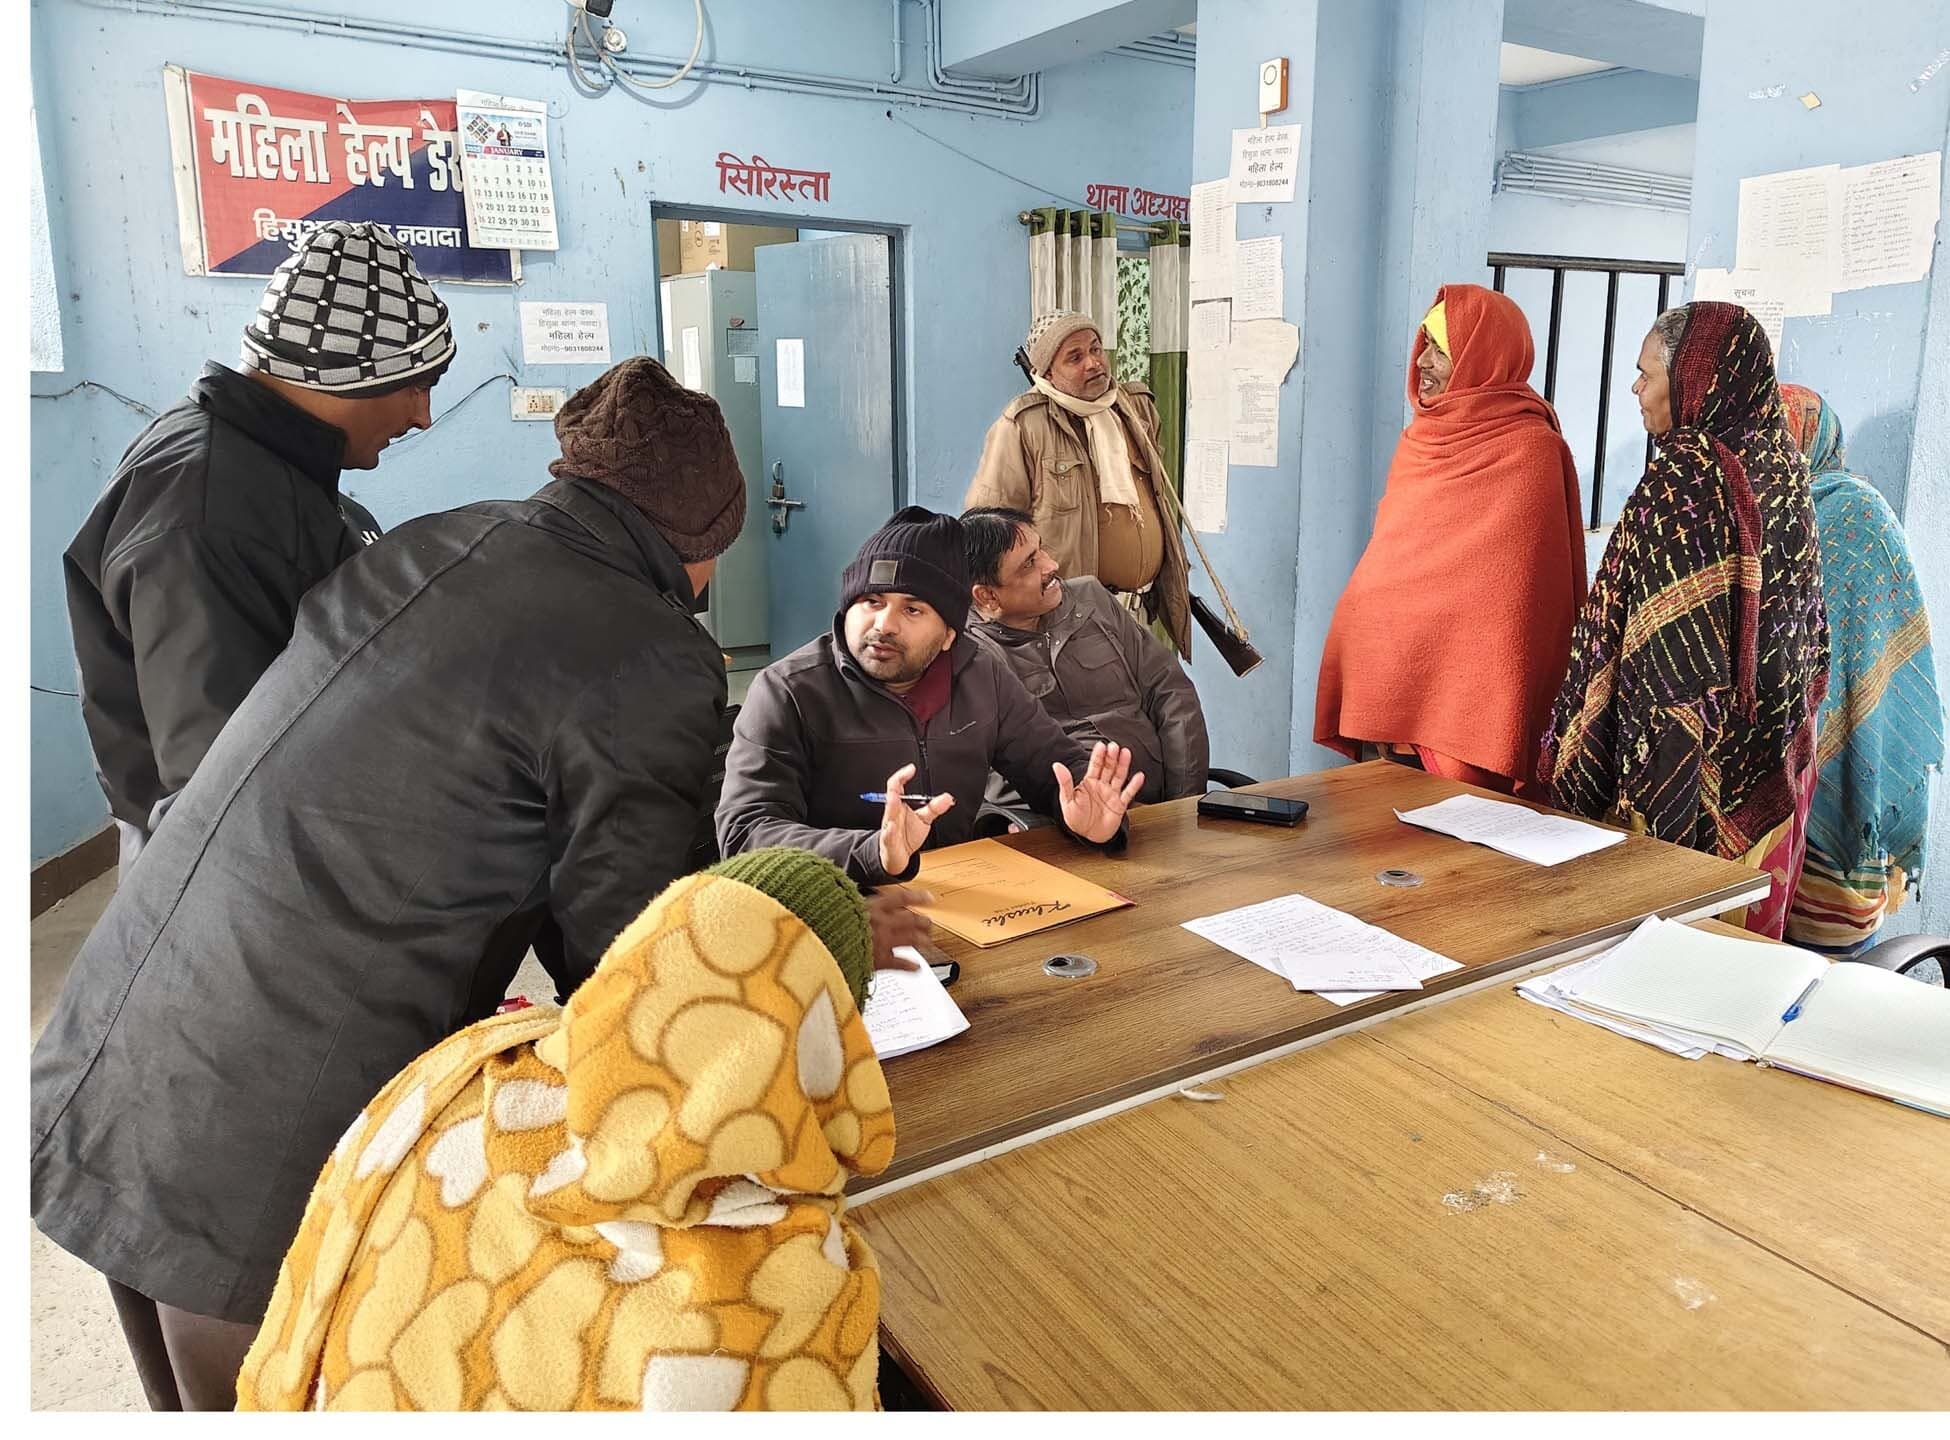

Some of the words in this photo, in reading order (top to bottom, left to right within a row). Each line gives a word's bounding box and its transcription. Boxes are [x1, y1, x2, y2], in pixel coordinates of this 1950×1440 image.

[204, 93, 332, 184] महिला
[336, 103, 415, 190] हेल्प
[491, 146, 523, 156] JANUARY
[1248, 161, 1267, 174] महिला
[715, 152, 831, 203] सिरिस्ता
[484, 190, 492, 198] 13
[495, 190, 503, 198] 14
[518, 192, 526, 200] 16
[530, 192, 536, 200] 17
[496, 204, 504, 212] 21
[508, 204, 516, 212] 22
[542, 206, 550, 214] 25
[1087, 184, 1130, 215] थाना
[1131, 188, 1191, 222] अध्यक्ष
[488, 216, 496, 224] 27
[499, 217, 507, 225] 28
[510, 218, 518, 226] 29
[396, 225, 462, 248] नवादा
[549, 330, 574, 340] महिला
[577, 329, 594, 340] हेल्प
